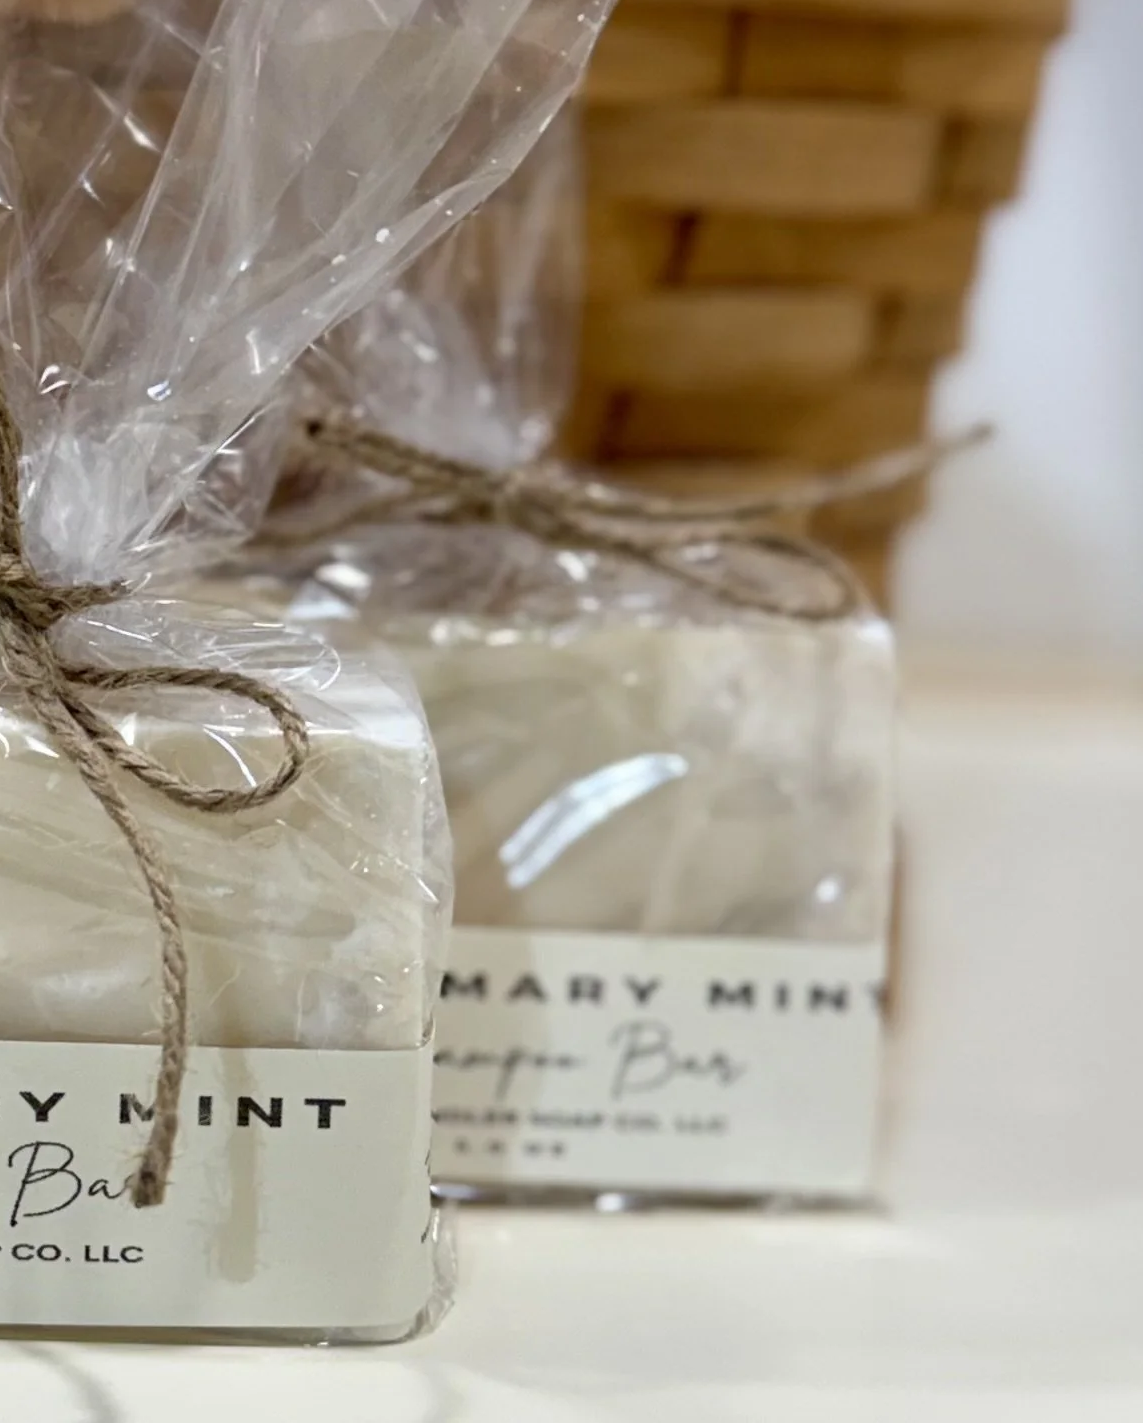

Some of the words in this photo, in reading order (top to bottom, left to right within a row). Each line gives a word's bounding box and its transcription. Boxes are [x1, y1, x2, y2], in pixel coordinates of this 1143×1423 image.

[440, 972, 663, 1009] MARY
[7, 1141, 141, 1228] Ba
[10, 1243, 71, 1263] CO.
[83, 1244, 145, 1264] LLC
